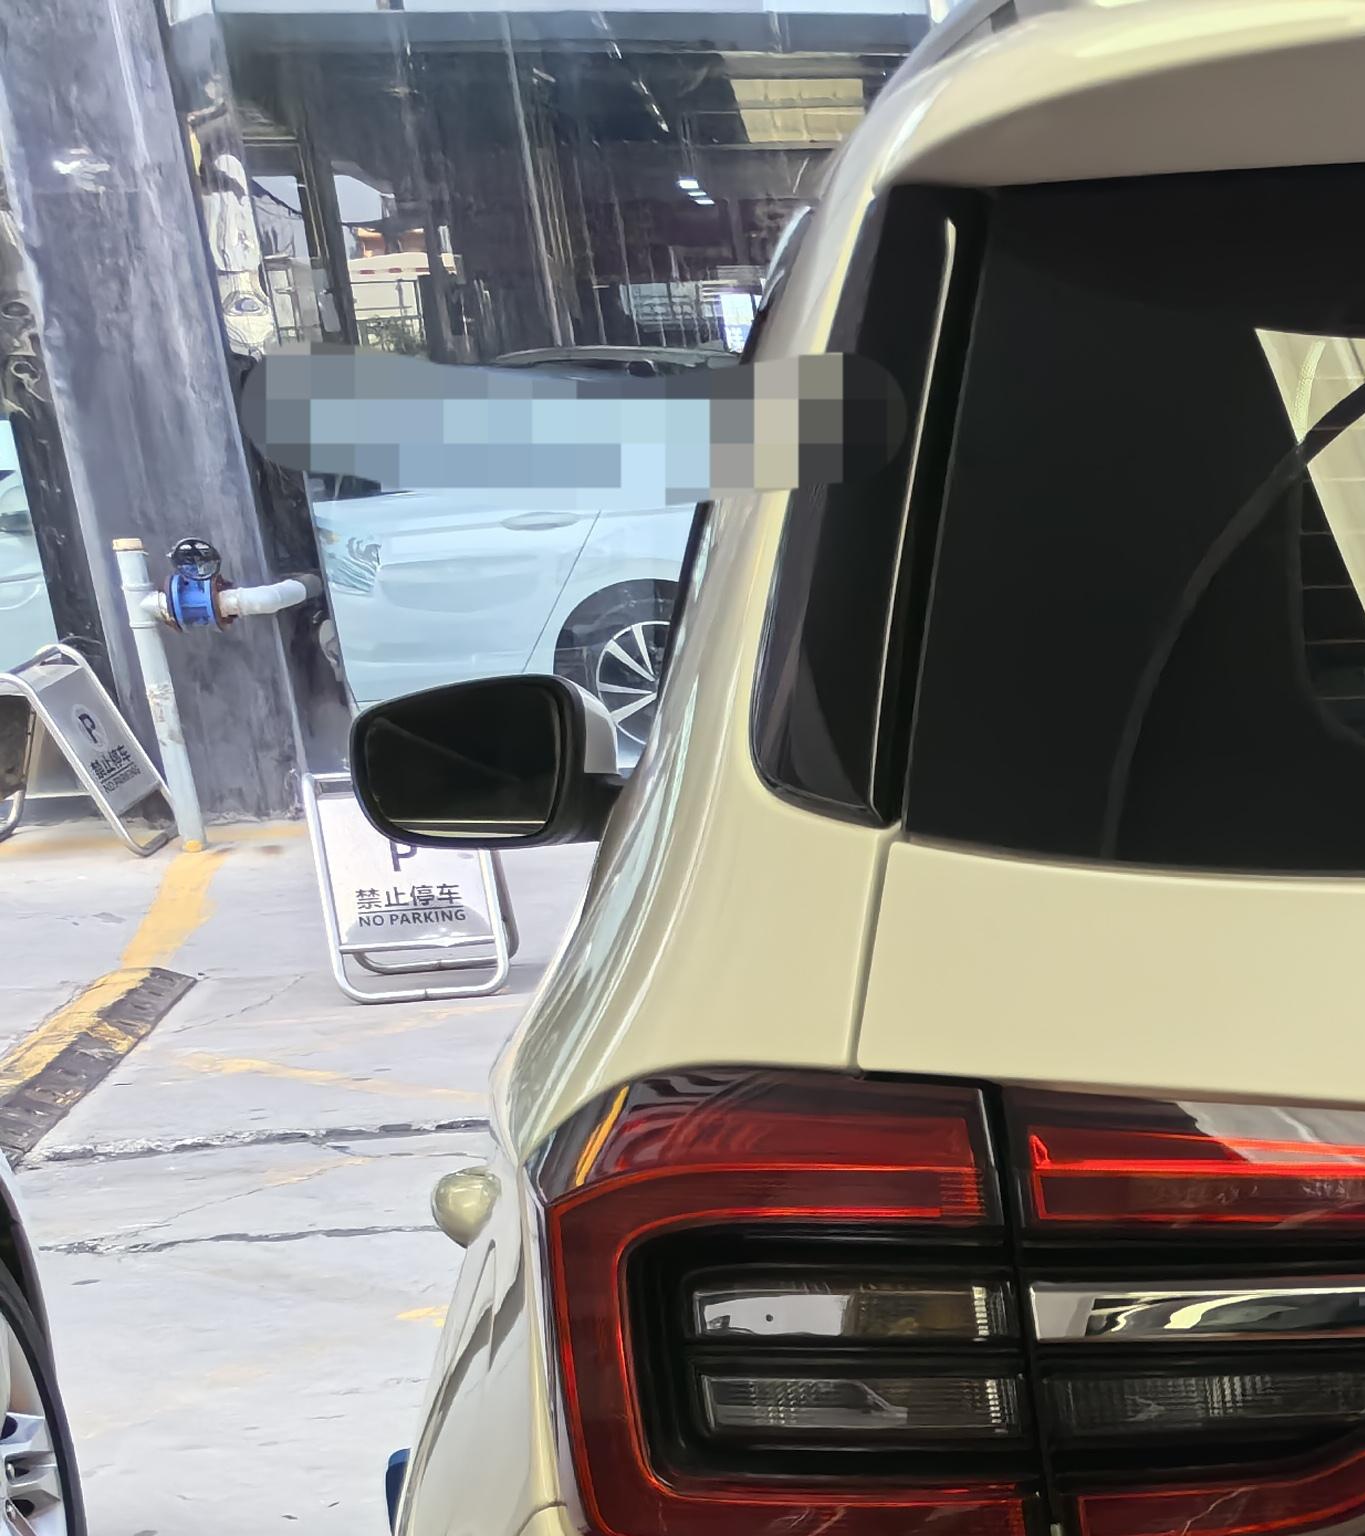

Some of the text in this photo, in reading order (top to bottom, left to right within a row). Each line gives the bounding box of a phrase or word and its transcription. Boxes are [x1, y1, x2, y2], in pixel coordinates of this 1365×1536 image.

[355, 883, 463, 910] 禁止停车
[358, 909, 467, 928] NO PARKING
